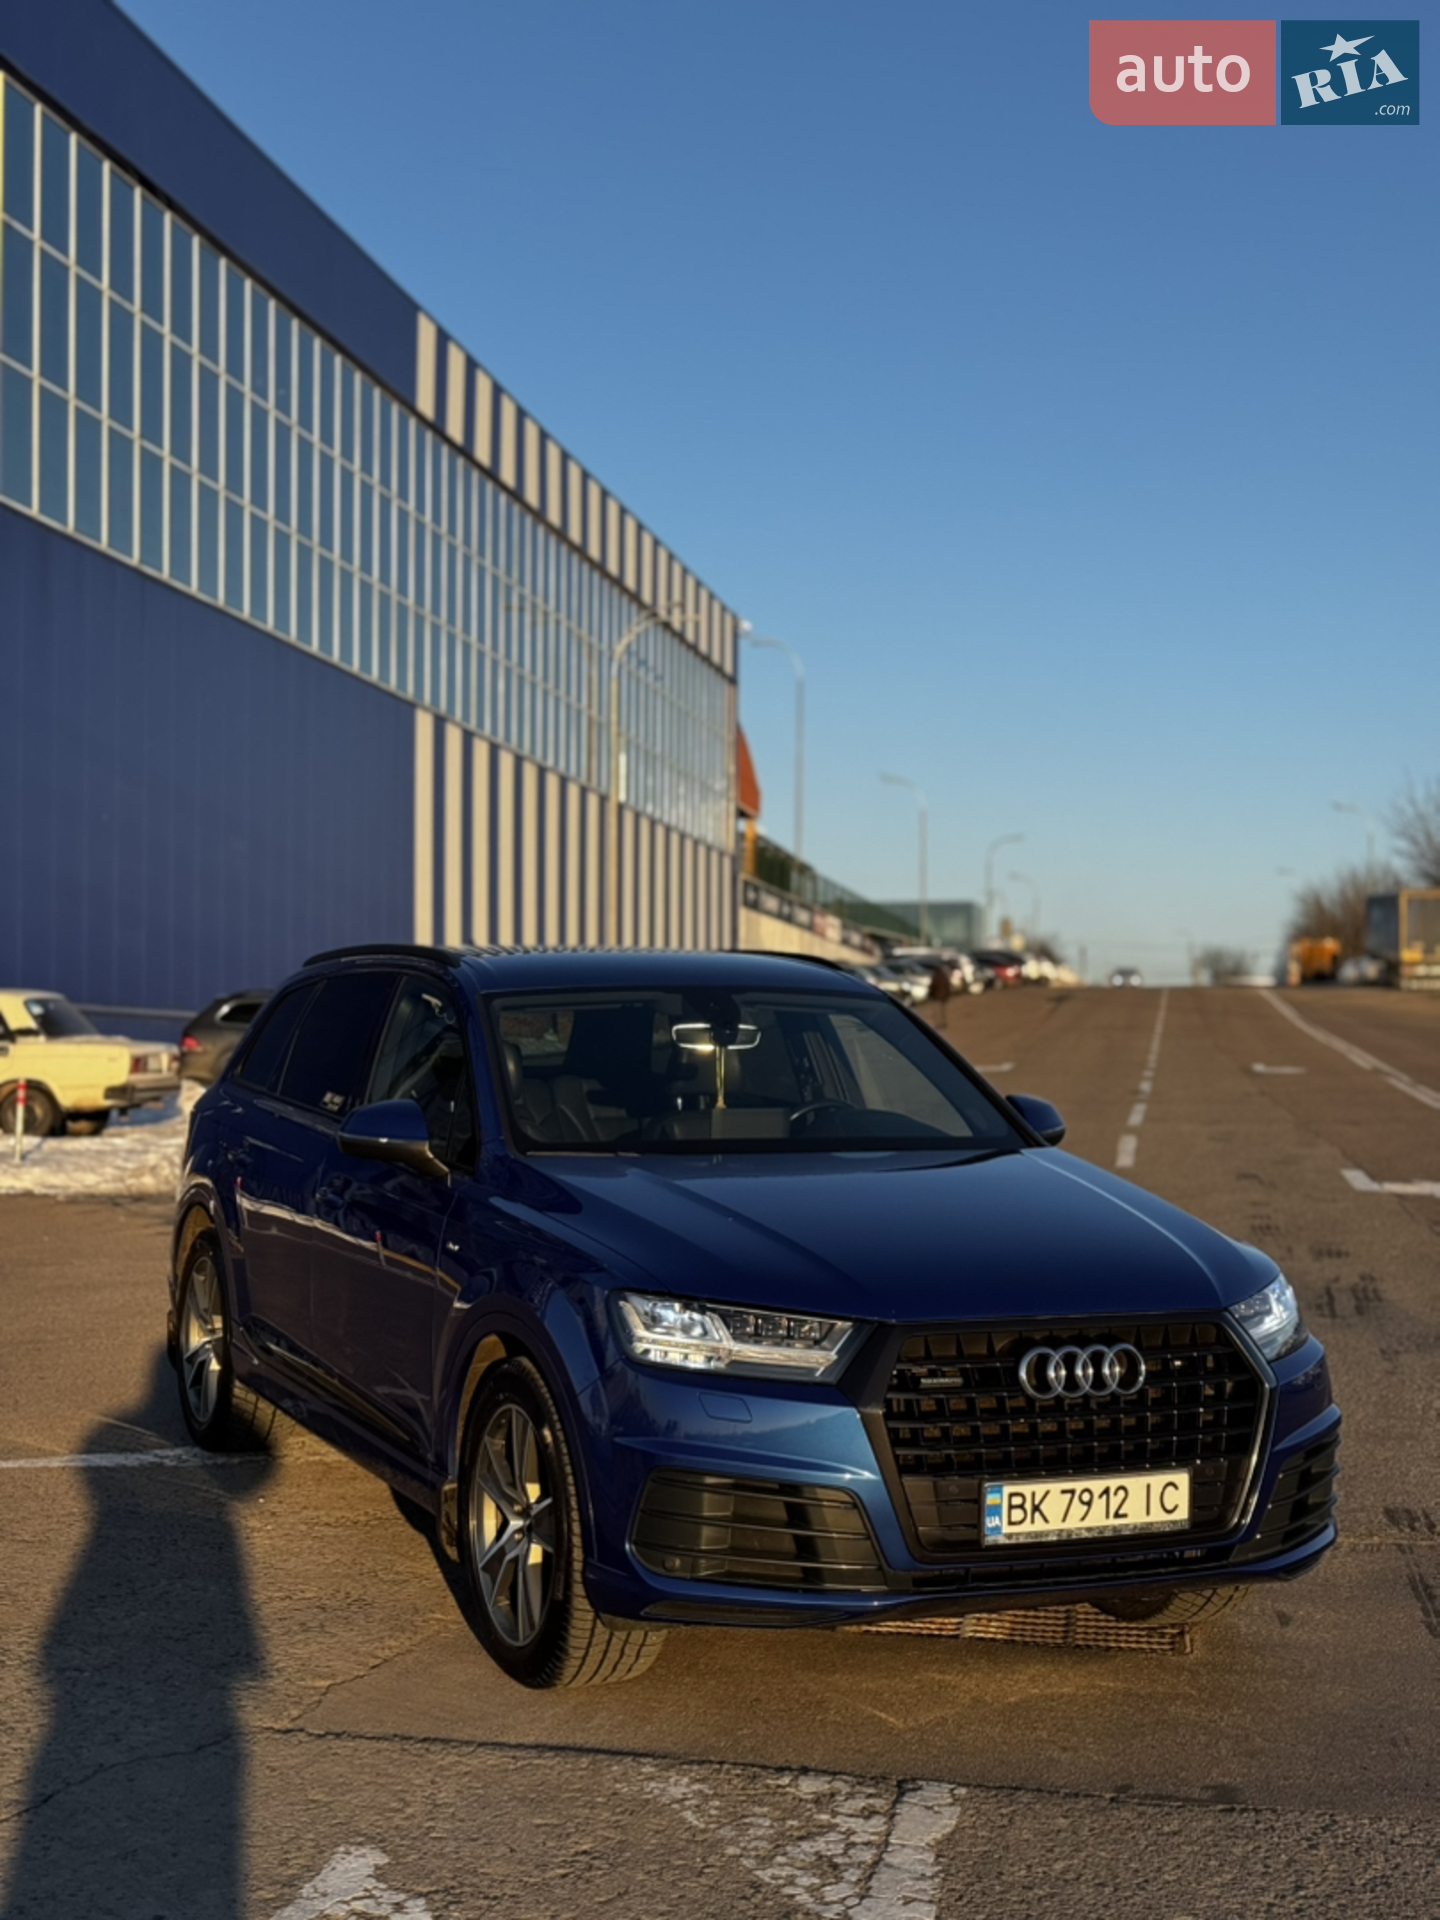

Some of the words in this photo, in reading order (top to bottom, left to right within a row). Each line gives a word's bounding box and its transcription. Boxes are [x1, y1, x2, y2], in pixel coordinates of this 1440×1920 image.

[1007, 1490, 1051, 1526] BK
[1060, 1485, 1129, 1523] 7912
[1145, 1481, 1180, 1517] IC
[986, 1516, 1001, 1528] UA
